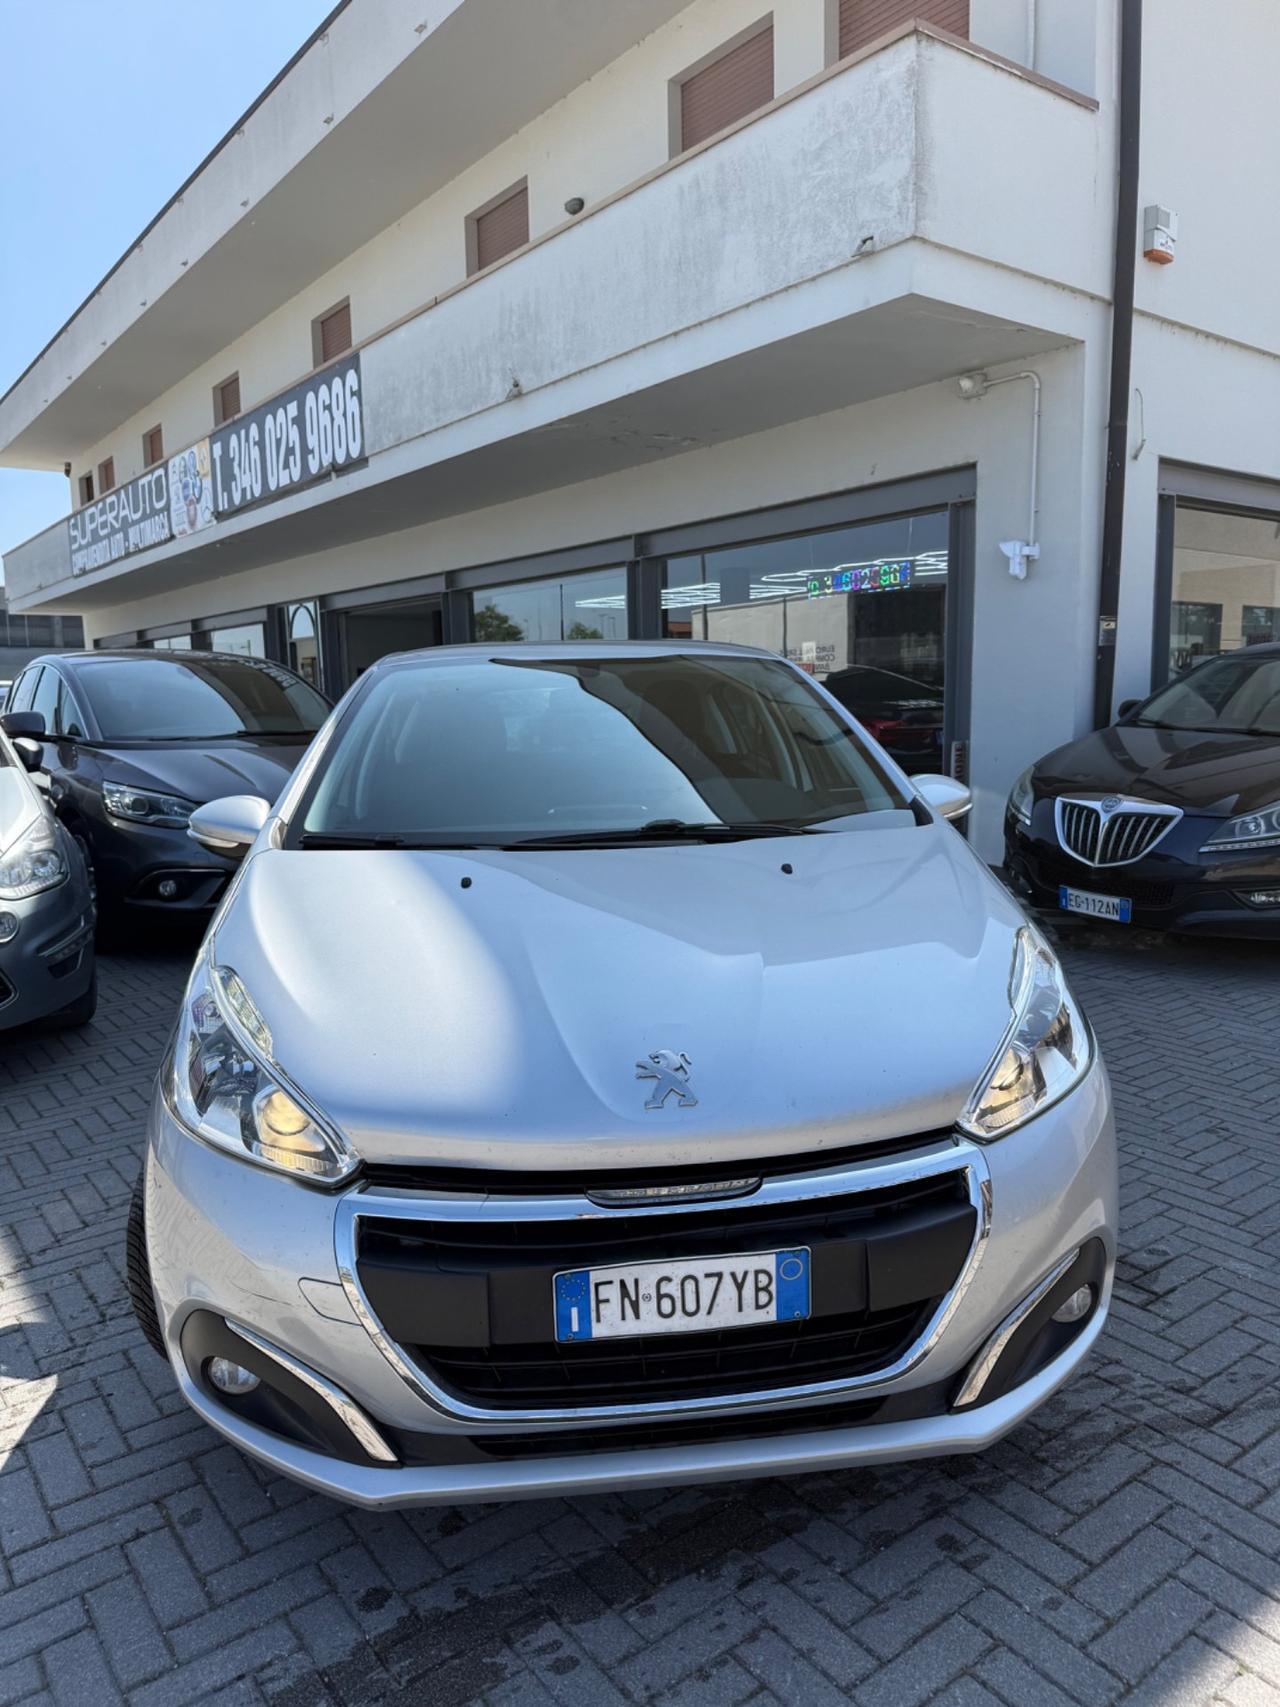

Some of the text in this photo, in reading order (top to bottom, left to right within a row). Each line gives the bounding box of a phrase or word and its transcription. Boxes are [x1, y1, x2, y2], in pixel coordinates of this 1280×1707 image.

[229, 422, 262, 506] 346
[264, 400, 302, 491] 025
[305, 369, 362, 475] 9686
[69, 467, 167, 550] SUPERAUTO
